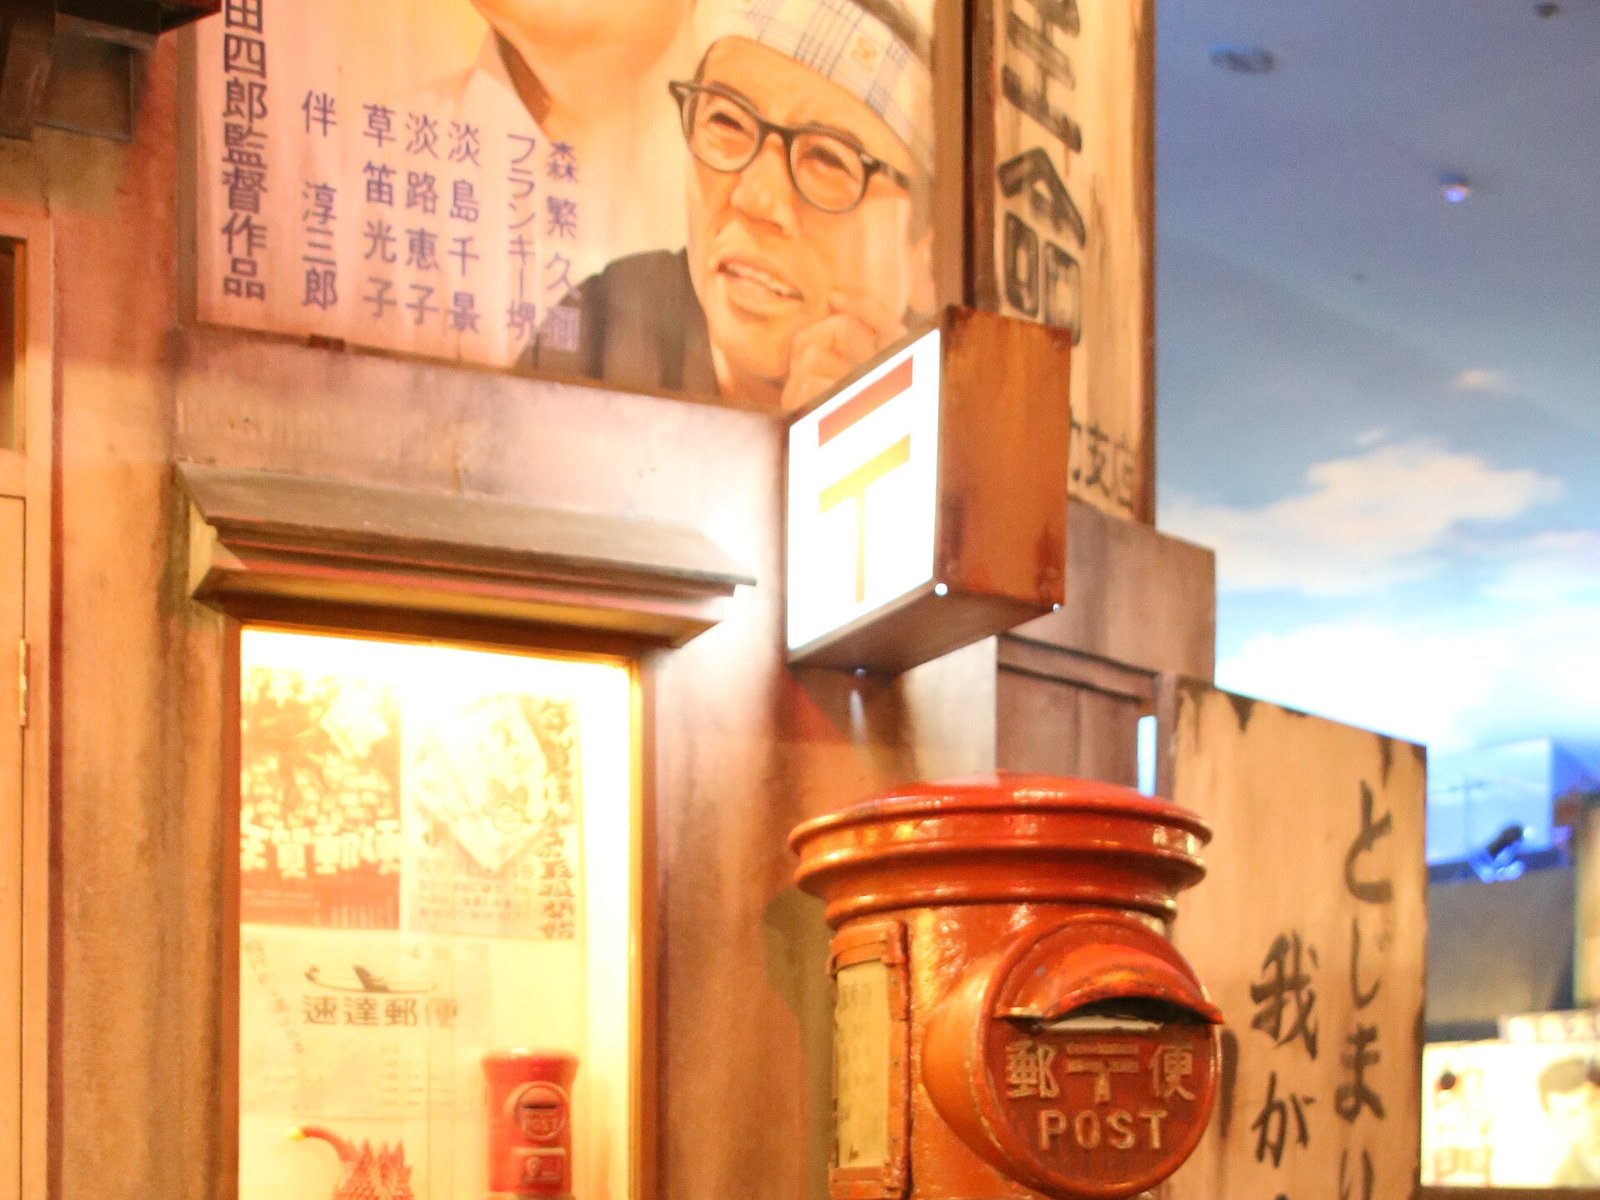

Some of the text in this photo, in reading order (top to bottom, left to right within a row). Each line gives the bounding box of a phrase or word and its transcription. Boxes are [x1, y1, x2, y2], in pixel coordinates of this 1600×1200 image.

[361, 103, 398, 320] 草笛光子
[404, 111, 440, 327] 淡路恵子
[448, 120, 481, 334] 淡島千景
[303, 995, 459, 1028] 速達郵便
[1038, 1108, 1168, 1152] POST
